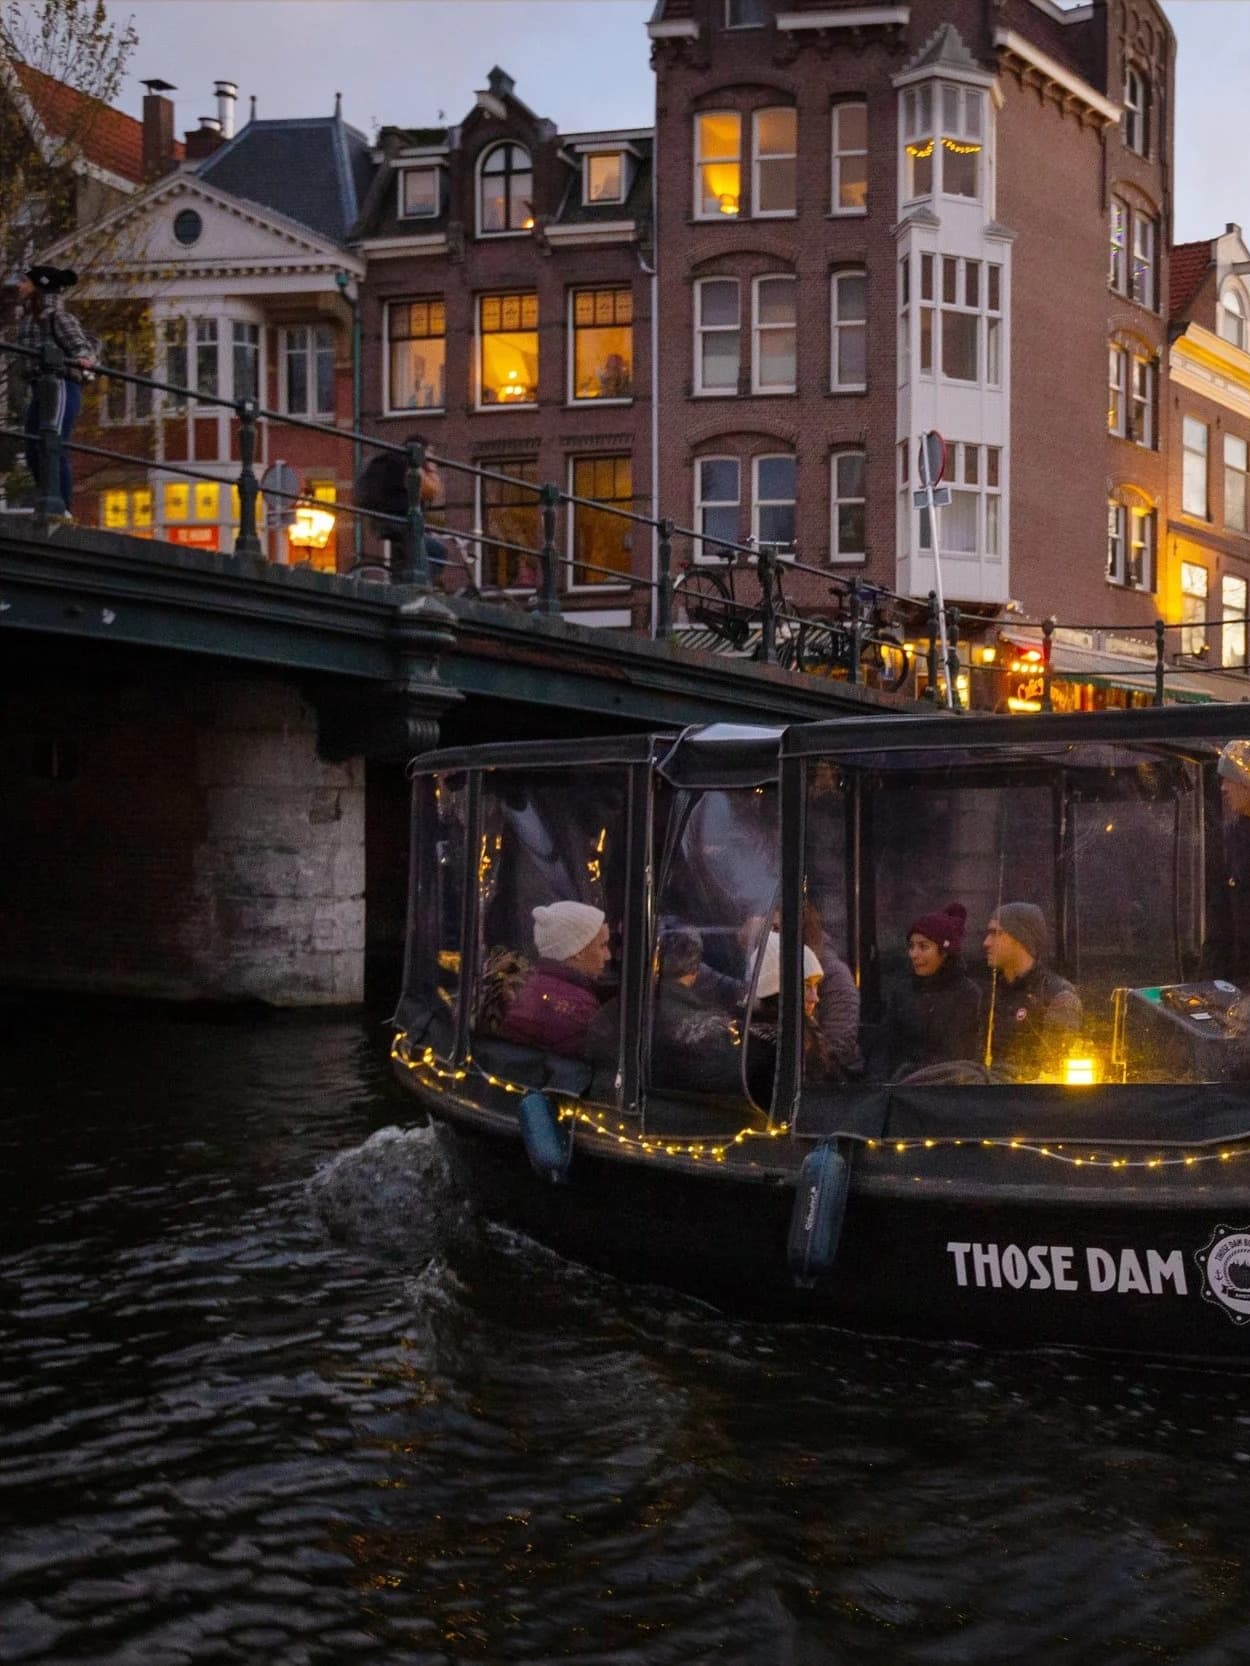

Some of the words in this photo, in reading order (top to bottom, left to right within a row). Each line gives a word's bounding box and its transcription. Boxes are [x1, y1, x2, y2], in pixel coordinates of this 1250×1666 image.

[1228, 1239, 1242, 1249] DAM
[947, 1242, 1078, 1291] THOSE
[1087, 1248, 1188, 1295] DAM
